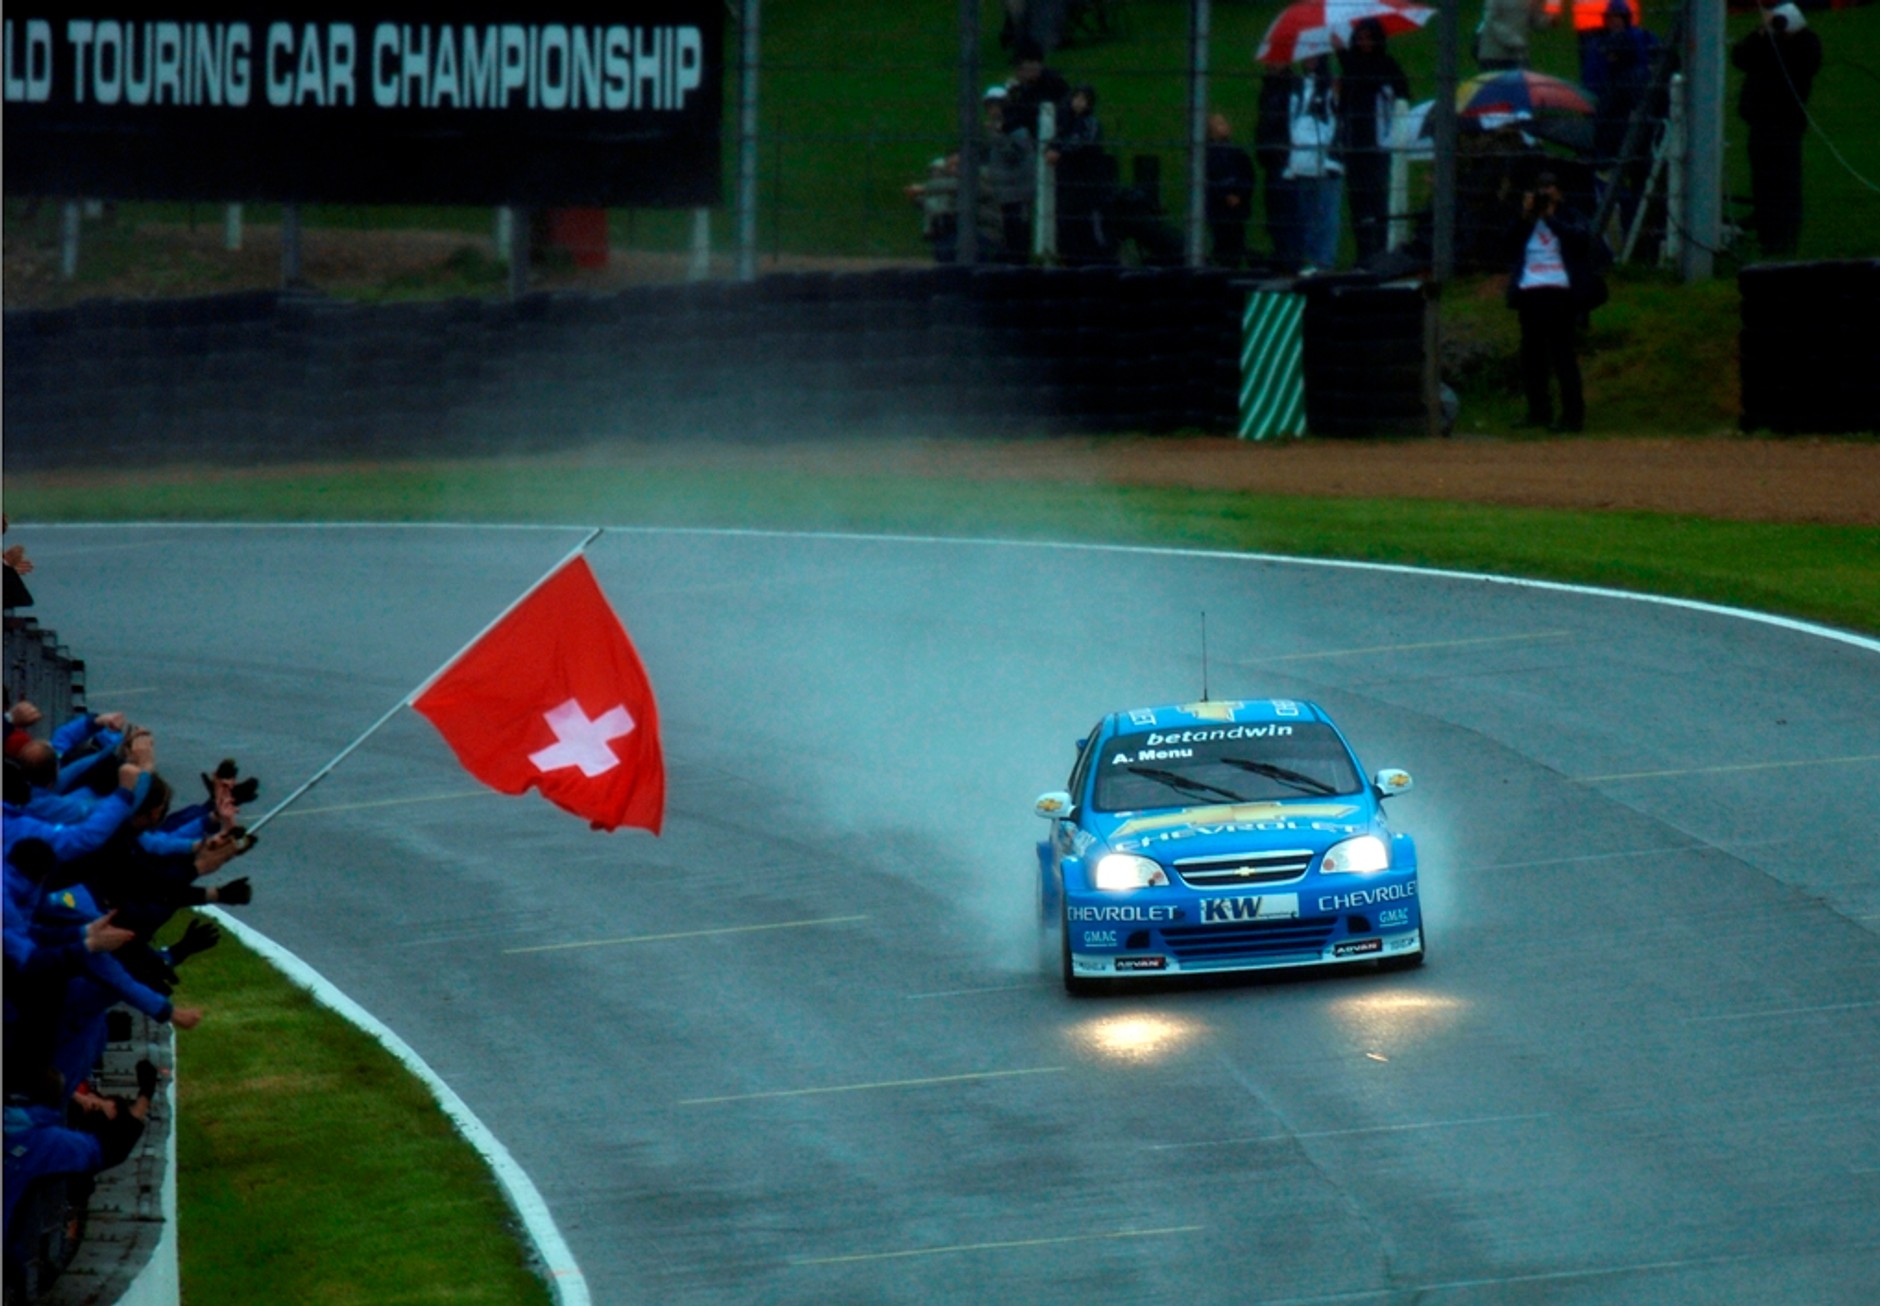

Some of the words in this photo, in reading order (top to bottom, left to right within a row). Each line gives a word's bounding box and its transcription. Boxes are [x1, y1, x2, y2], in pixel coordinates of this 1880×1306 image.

[3, 19, 52, 102] LD
[67, 20, 251, 106] TOURING
[266, 22, 356, 107] CAR
[372, 24, 702, 110] CHAMPIONSHIP
[1146, 724, 1294, 746] betandwin
[1112, 752, 1134, 765] A.
[1138, 747, 1193, 762] Menu
[1318, 880, 1417, 912] CHEVROLE
[1067, 905, 1178, 921] CHEVROLET
[1205, 896, 1262, 920] KW
[1379, 907, 1409, 923] GMAC
[1084, 930, 1117, 943] GMAC
